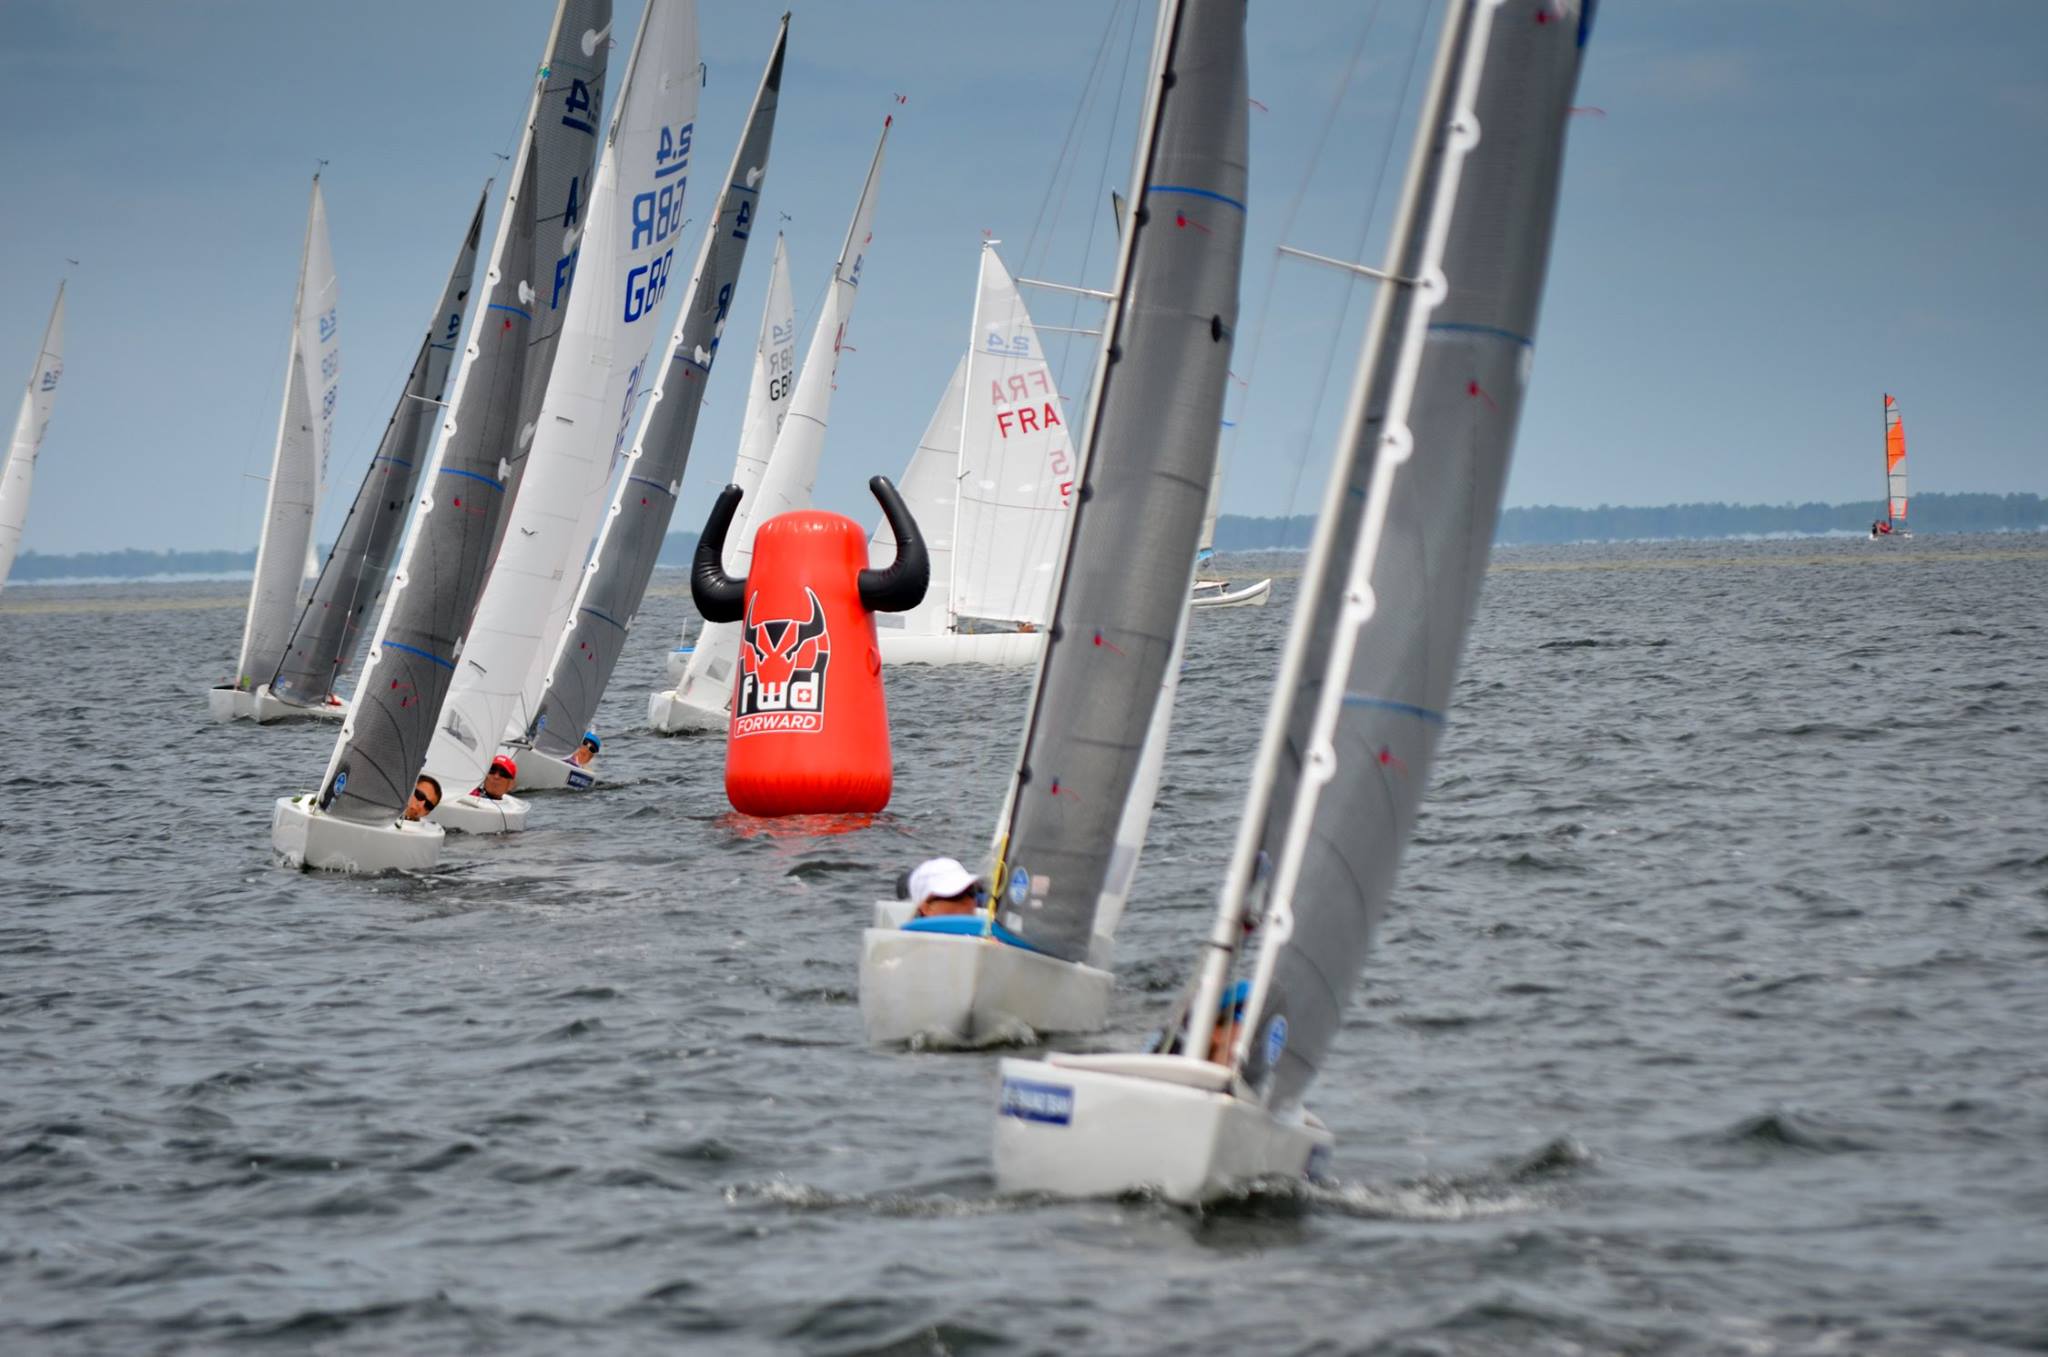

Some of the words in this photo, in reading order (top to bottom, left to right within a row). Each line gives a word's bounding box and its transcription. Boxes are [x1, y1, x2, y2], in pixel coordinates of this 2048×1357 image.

[623, 248, 674, 323] GBR
[997, 402, 1061, 438] FRA
[741, 672, 820, 714] fwd
[736, 714, 817, 734] FORWARD
